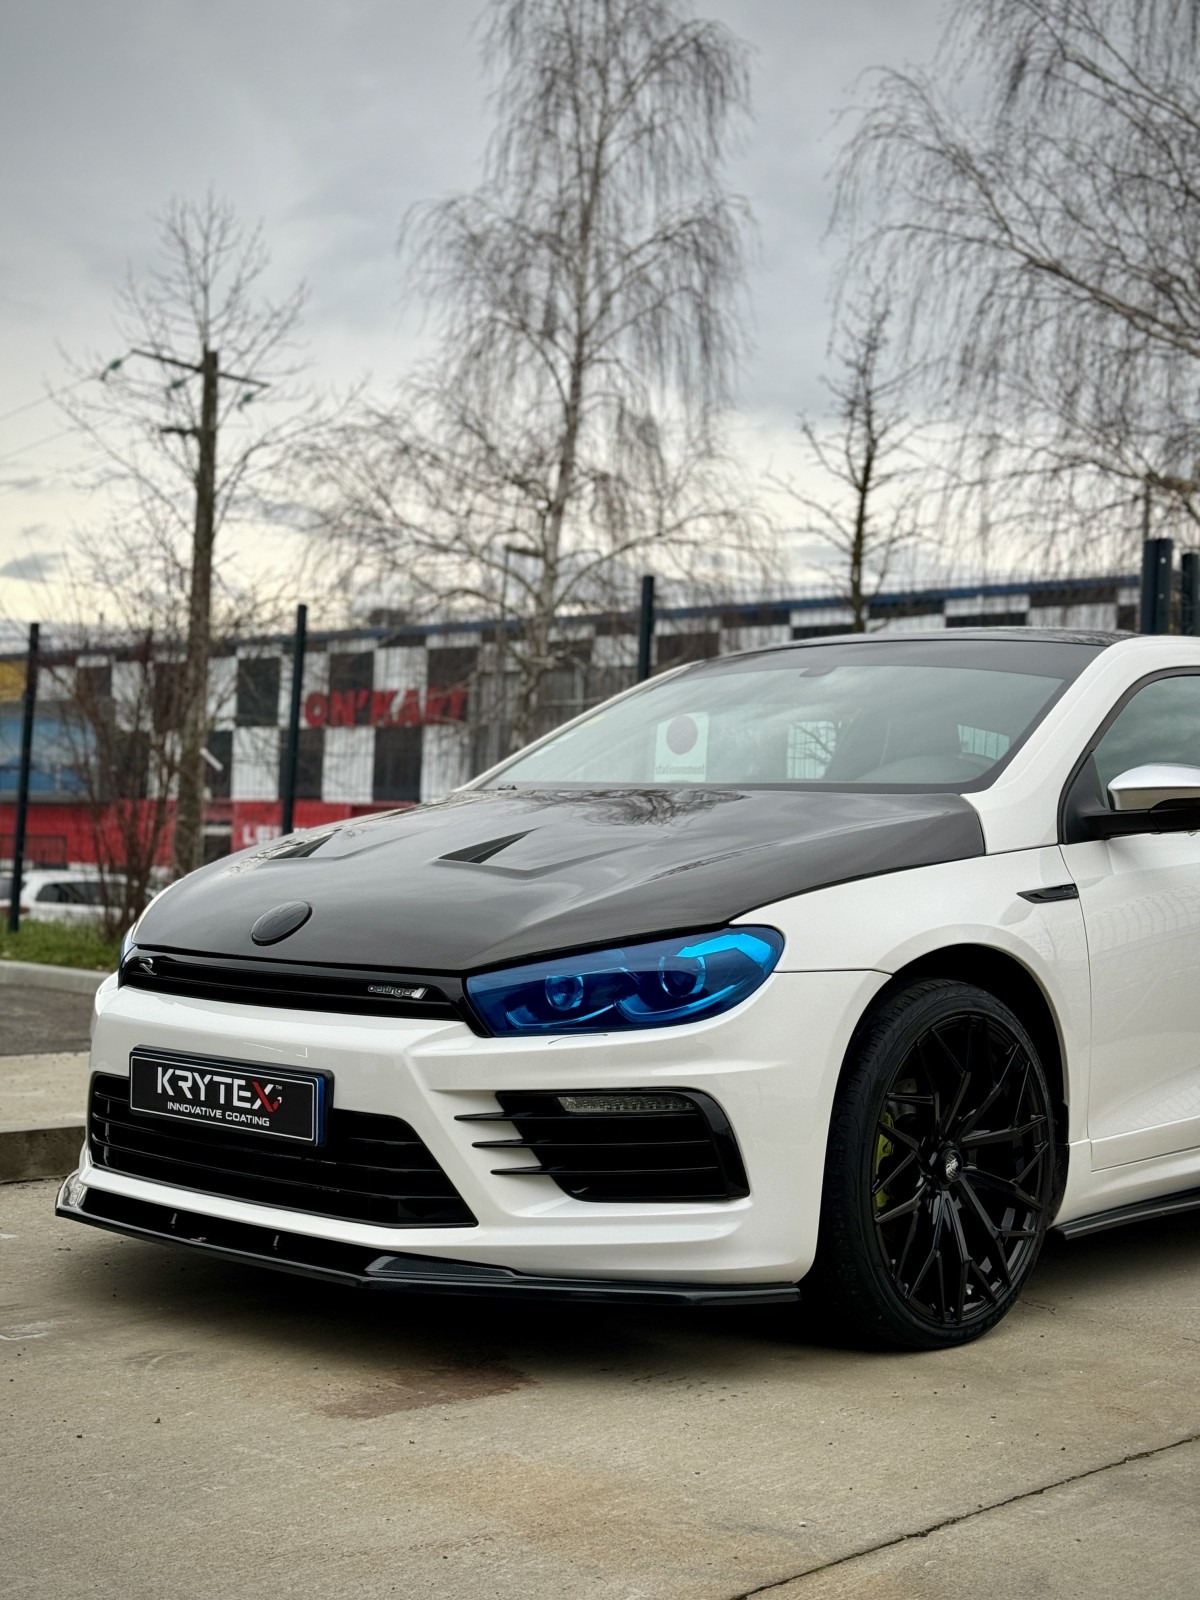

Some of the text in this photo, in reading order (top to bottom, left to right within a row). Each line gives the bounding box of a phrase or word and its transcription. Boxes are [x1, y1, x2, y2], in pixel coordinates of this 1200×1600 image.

[156, 1066, 282, 1113] KRYTEX
[167, 1101, 270, 1127] INNOVATIVE COATING
